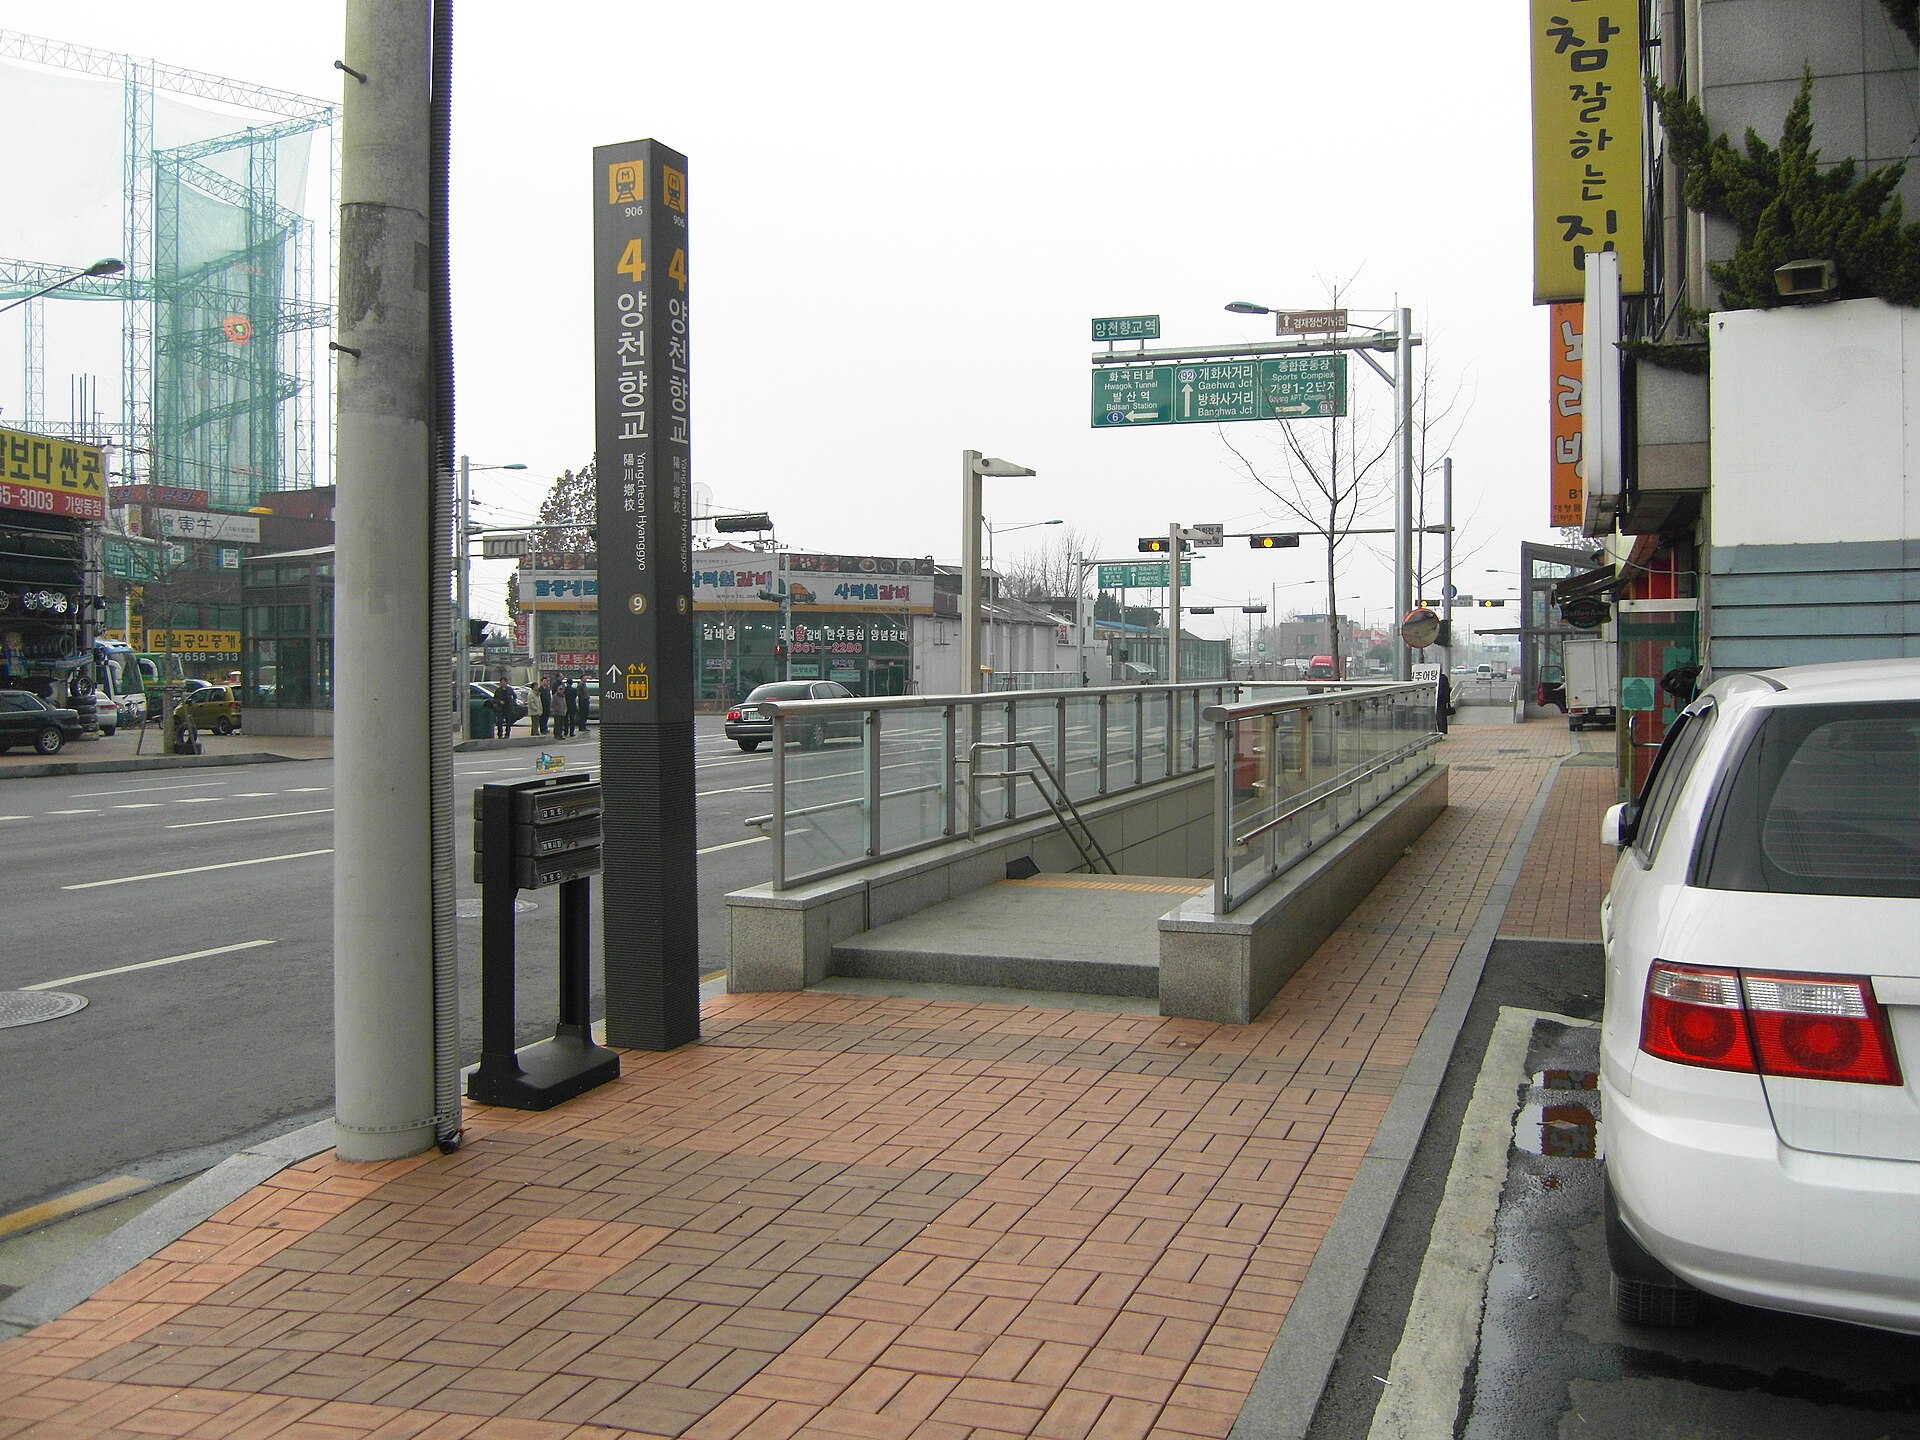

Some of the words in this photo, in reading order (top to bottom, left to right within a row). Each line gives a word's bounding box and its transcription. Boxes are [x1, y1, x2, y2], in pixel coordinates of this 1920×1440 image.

[625, 206, 643, 217] 906
[673, 215, 685, 228] 906
[617, 239, 646, 283] 4
[668, 247, 688, 292] 4
[617, 290, 649, 440] 양천향교
[669, 298, 689, 445] 양천향교
[1278, 359, 1330, 373] 종합운동장
[1108, 369, 1154, 383] 화곡터널
[1181, 371, 1194, 381] 92
[1198, 365, 1253, 381] 개화사거리
[1272, 373, 1298, 382] Sports
[1301, 371, 1334, 380] Complex
[1104, 383, 1133, 391] Hwagok
[1135, 381, 1158, 389] Tunnel
[1198, 381, 1236, 390] Gaehwa
[1238, 380, 1253, 388] Jct
[1198, 390, 1254, 406] 방화사거리
[1106, 403, 1130, 411] Balsan
[1132, 402, 1158, 410] Station
[1197, 407, 1237, 418] Banghwa
[1239, 406, 1253, 414] Jct
[1112, 412, 1118, 422] 6
[635, 452, 647, 514] Yangcheon
[65, 496, 102, 516] 가양동점
[635, 515, 647, 571] Hyanggyo
[634, 597, 642, 611] 9
[679, 598, 686, 611] 9
[827, 629, 865, 641] 한우등심
[871, 629, 908, 642] 양념갈비
[559, 653, 597, 664] 부동산
[605, 691, 624, 700] 40m
